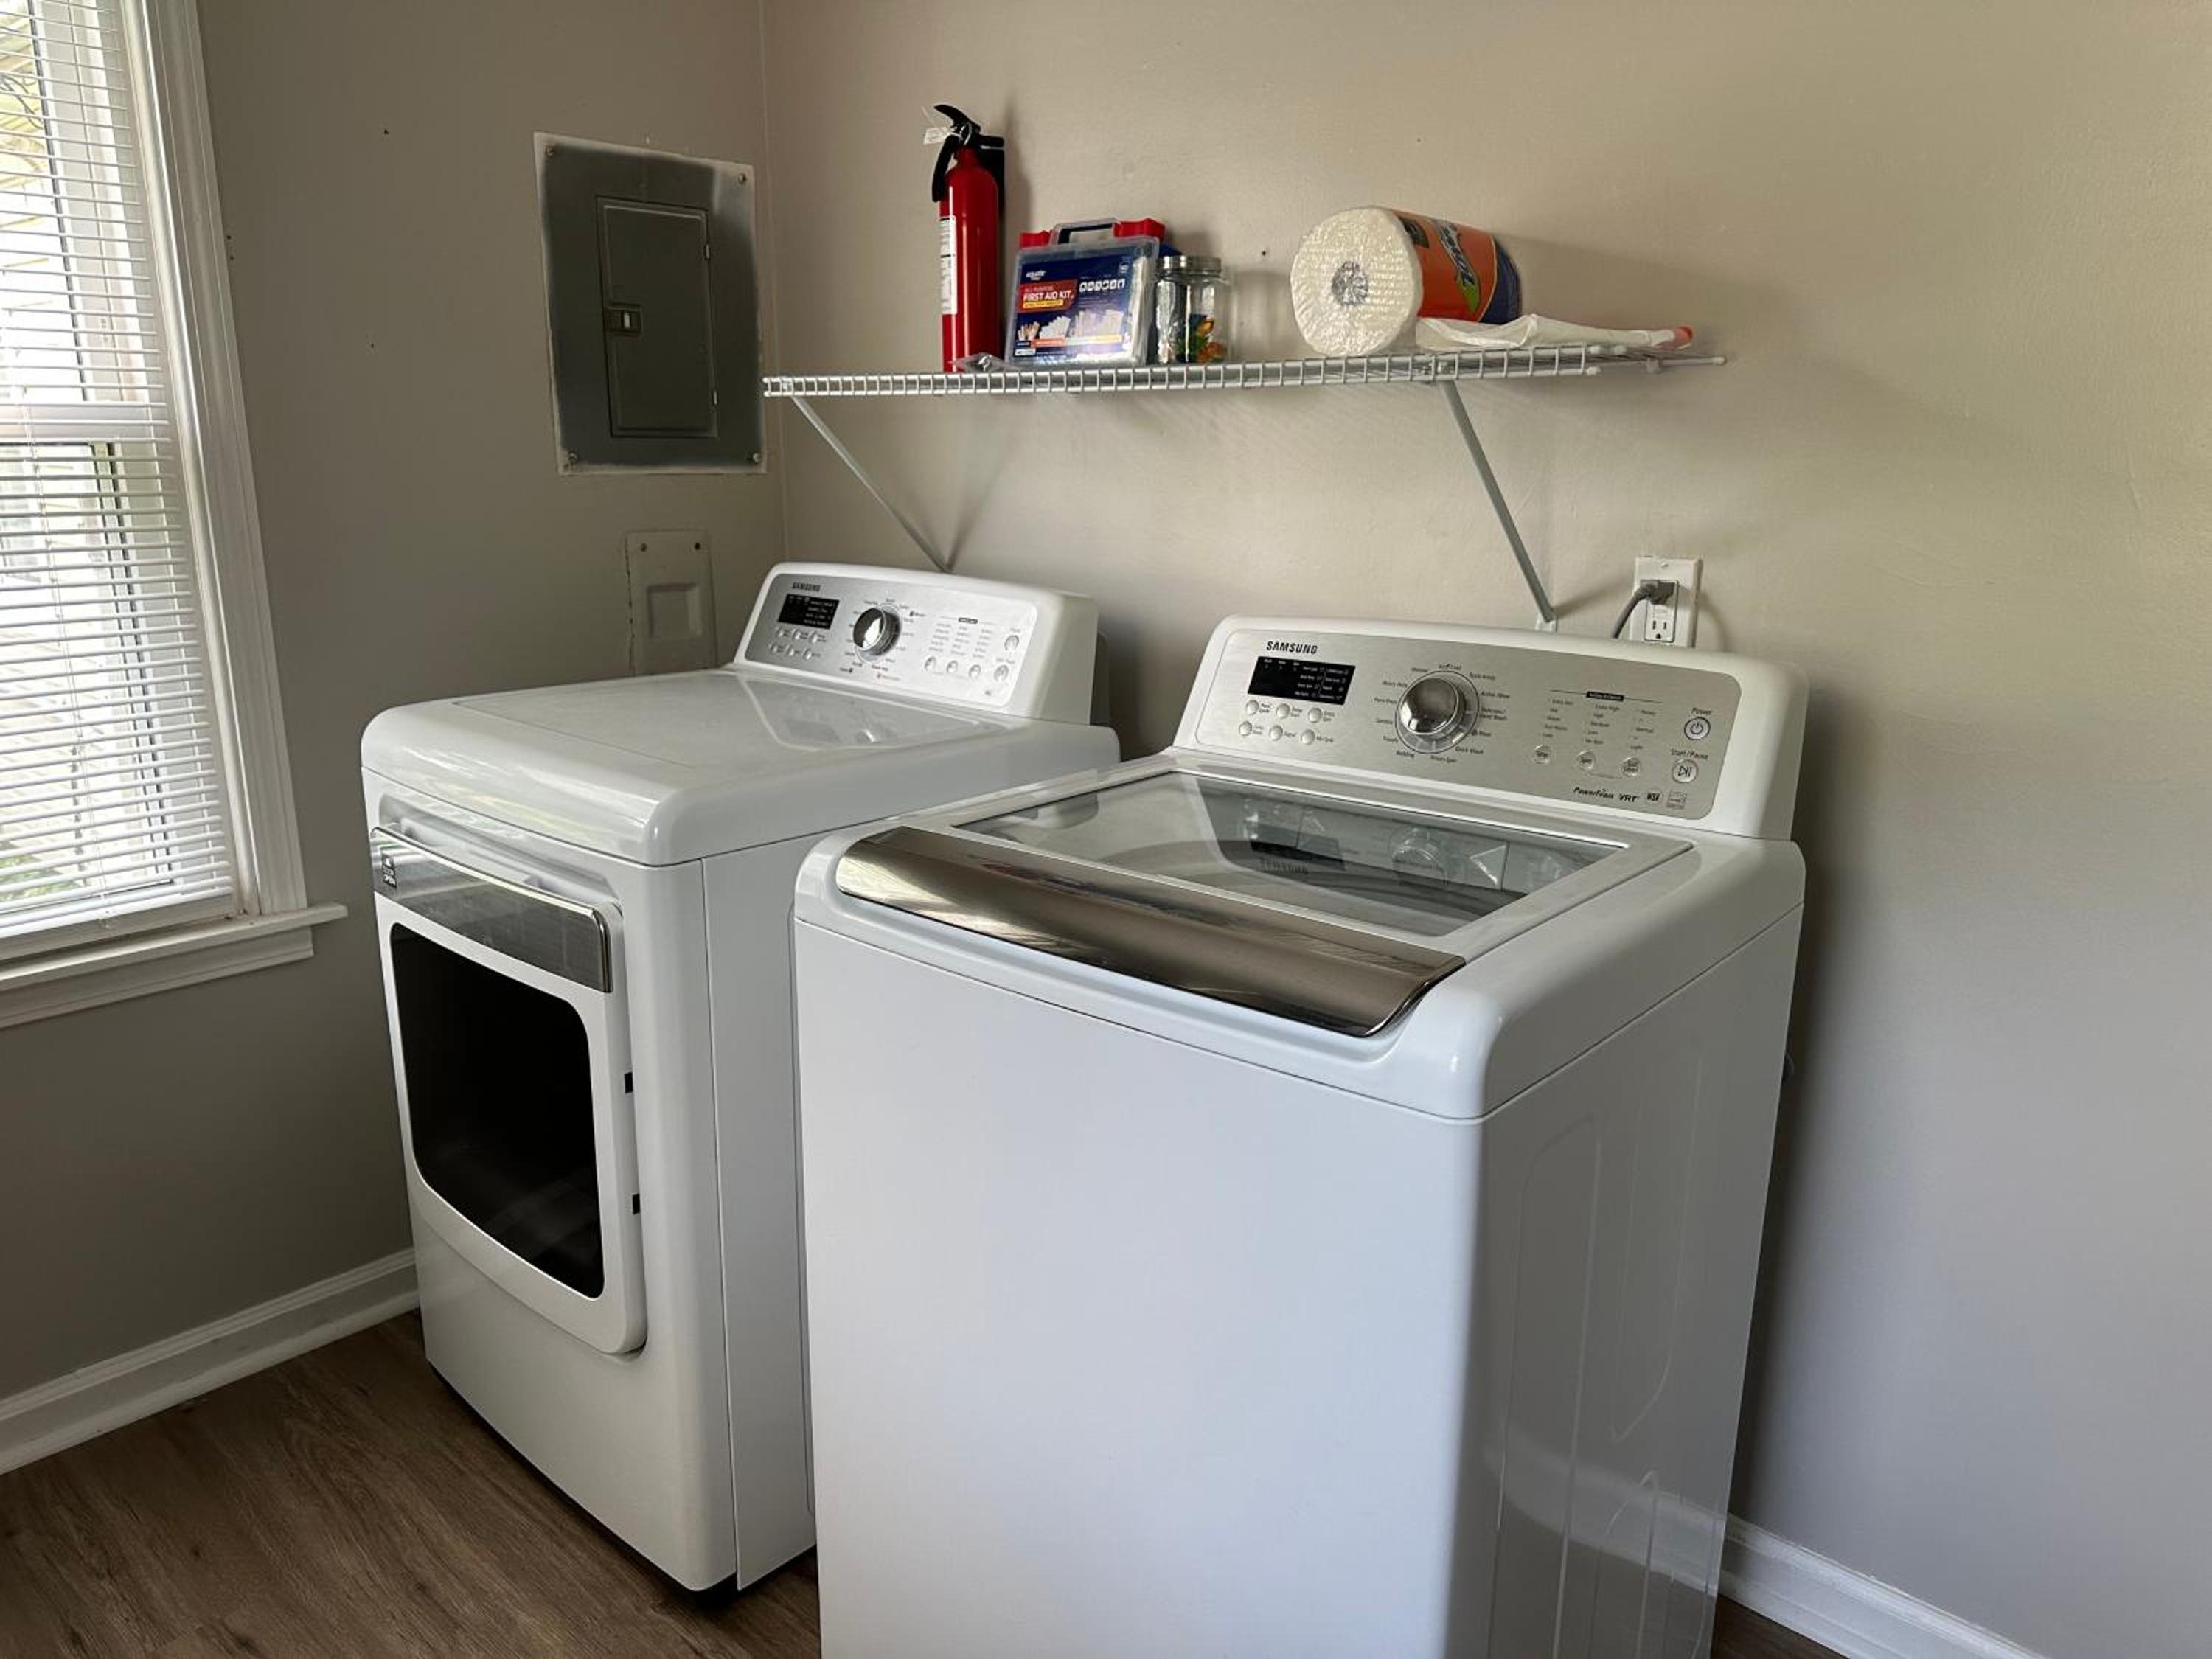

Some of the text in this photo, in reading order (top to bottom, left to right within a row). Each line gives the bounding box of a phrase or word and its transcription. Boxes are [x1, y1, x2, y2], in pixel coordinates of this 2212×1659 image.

[1045, 291, 1058, 300] AID
[1060, 290, 1071, 299] KIT
[1265, 640, 1318, 655] SAMSUNG
[1691, 707, 1711, 716] Power
[1619, 793, 1638, 802] VRT
